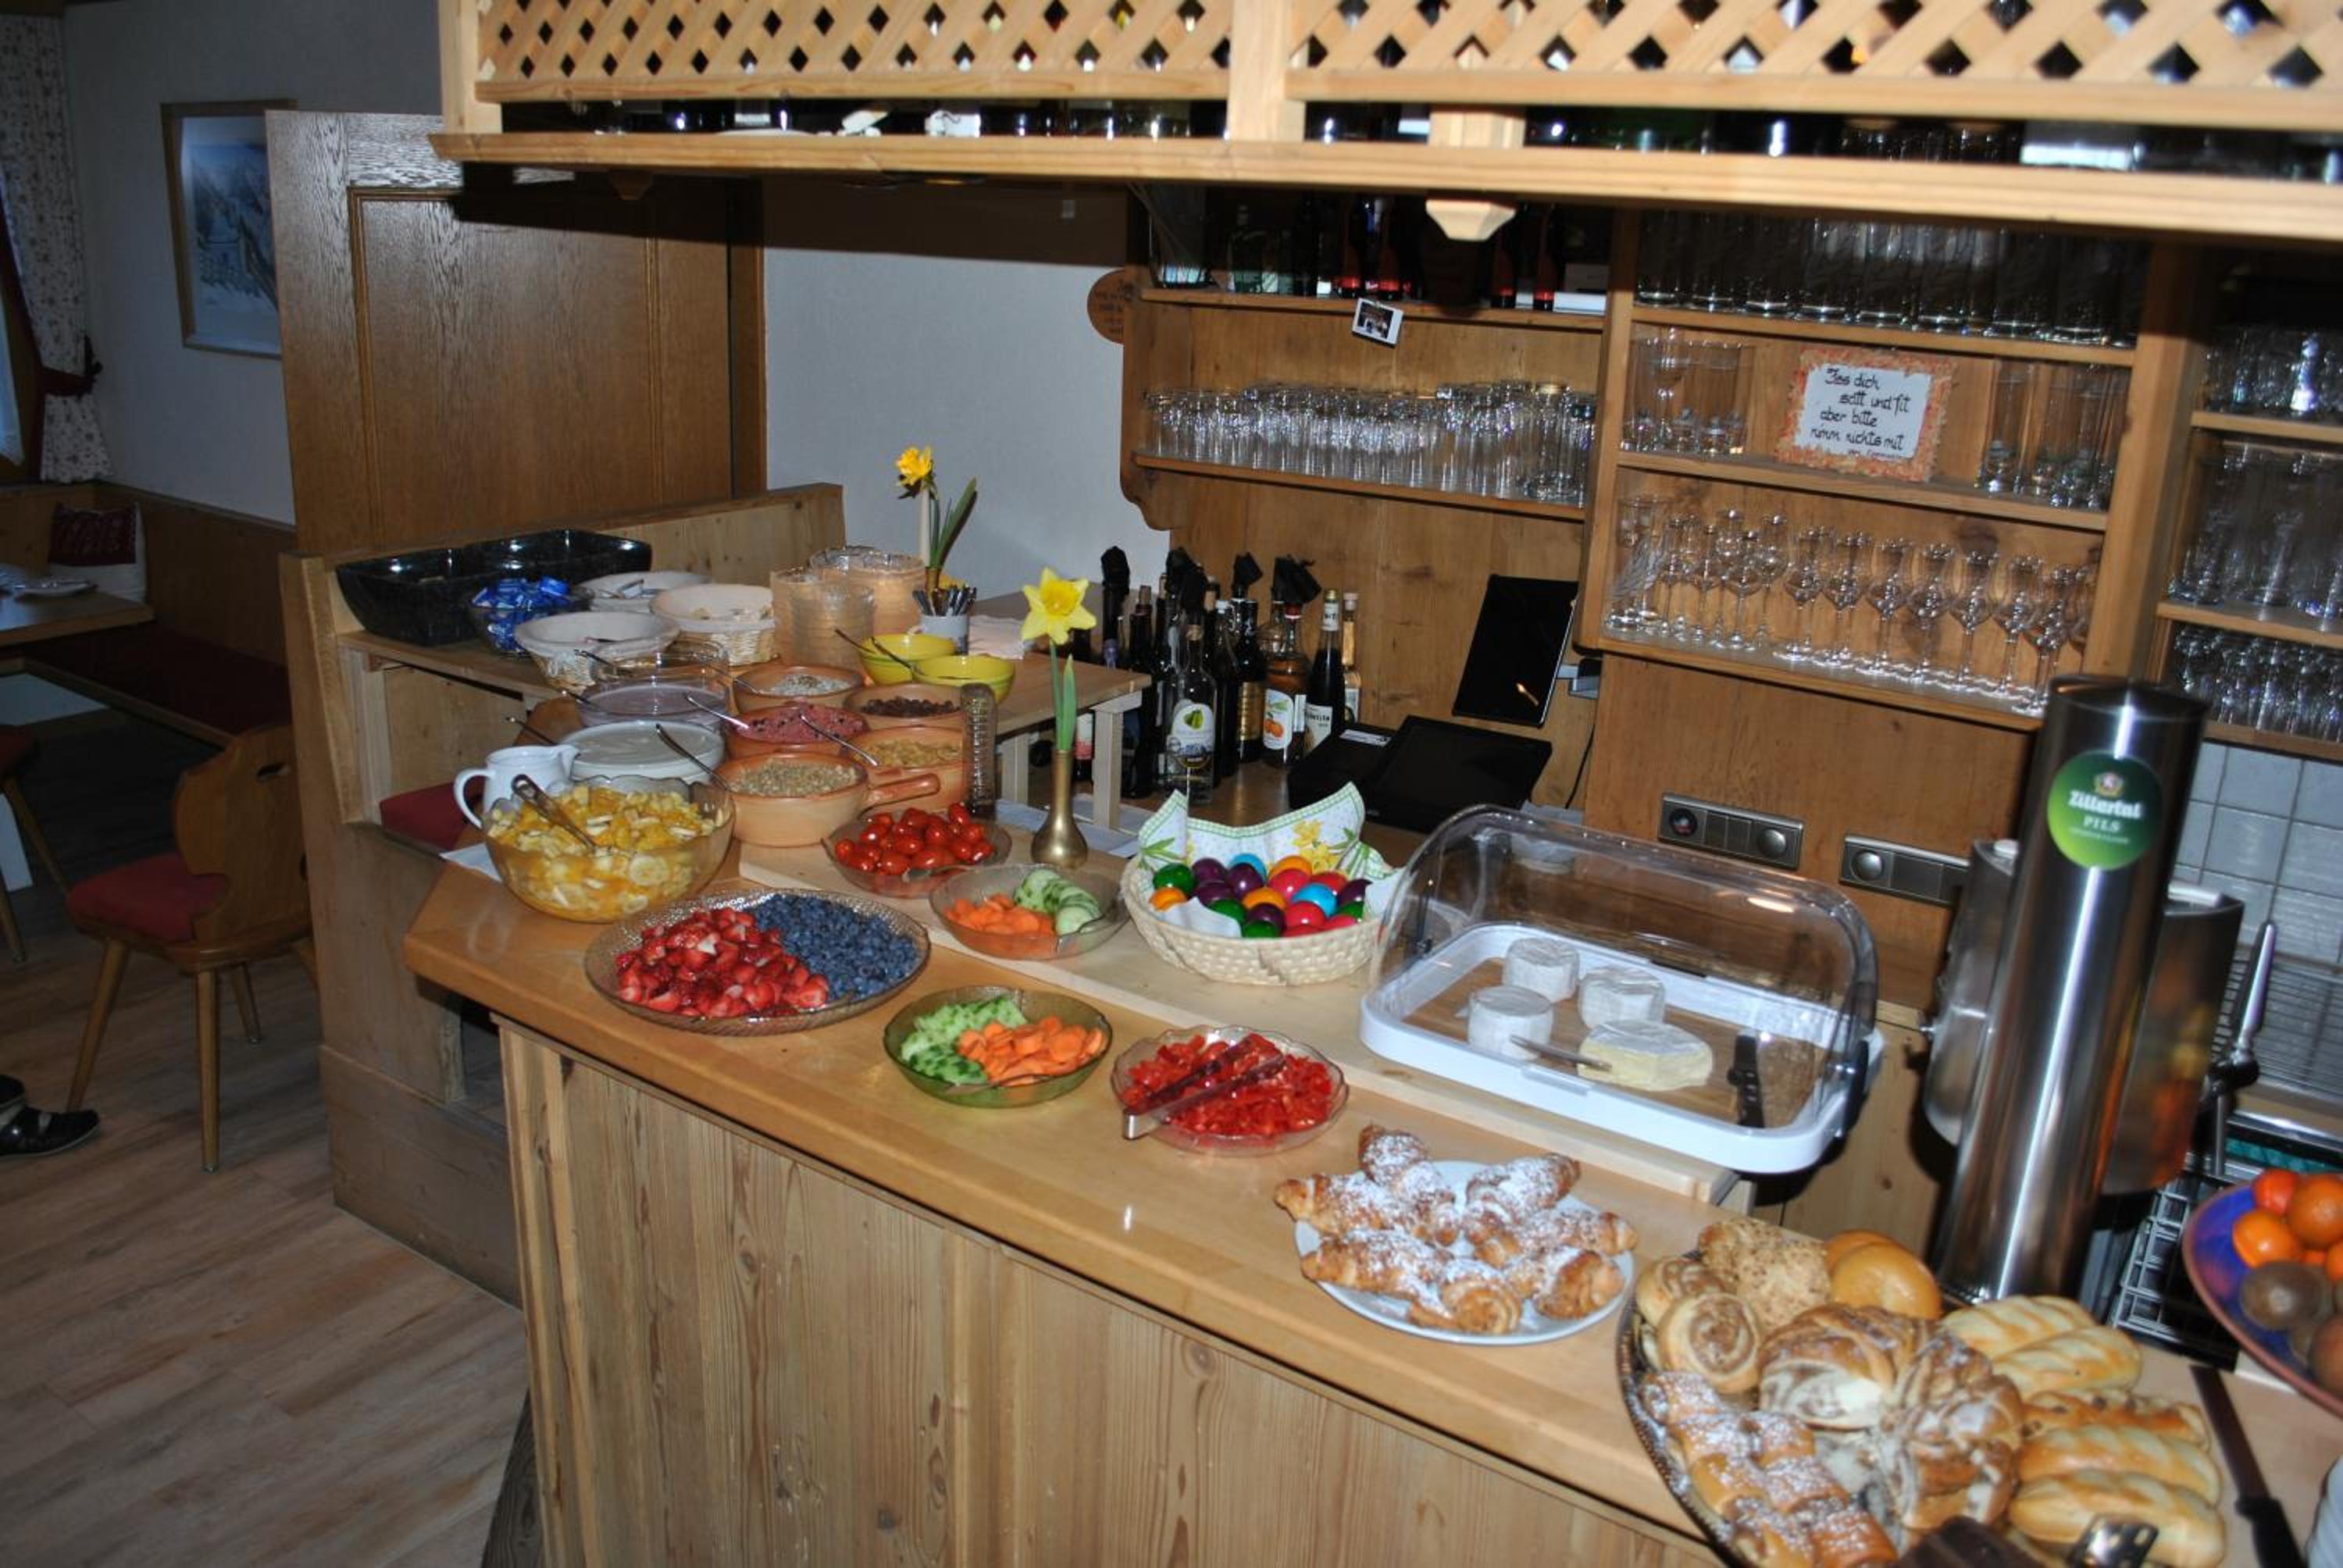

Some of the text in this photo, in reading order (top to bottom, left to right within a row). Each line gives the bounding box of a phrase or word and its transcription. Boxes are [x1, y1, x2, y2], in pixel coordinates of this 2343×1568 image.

[1853, 374, 1880, 390] dich
[1839, 390, 1911, 418] satt und fit
[1820, 407, 1878, 427] aber bitte
[1810, 424, 1904, 451] nimm nichts mit
[2067, 788, 2142, 820] Zillertal
[2083, 814, 2121, 832] PILS
